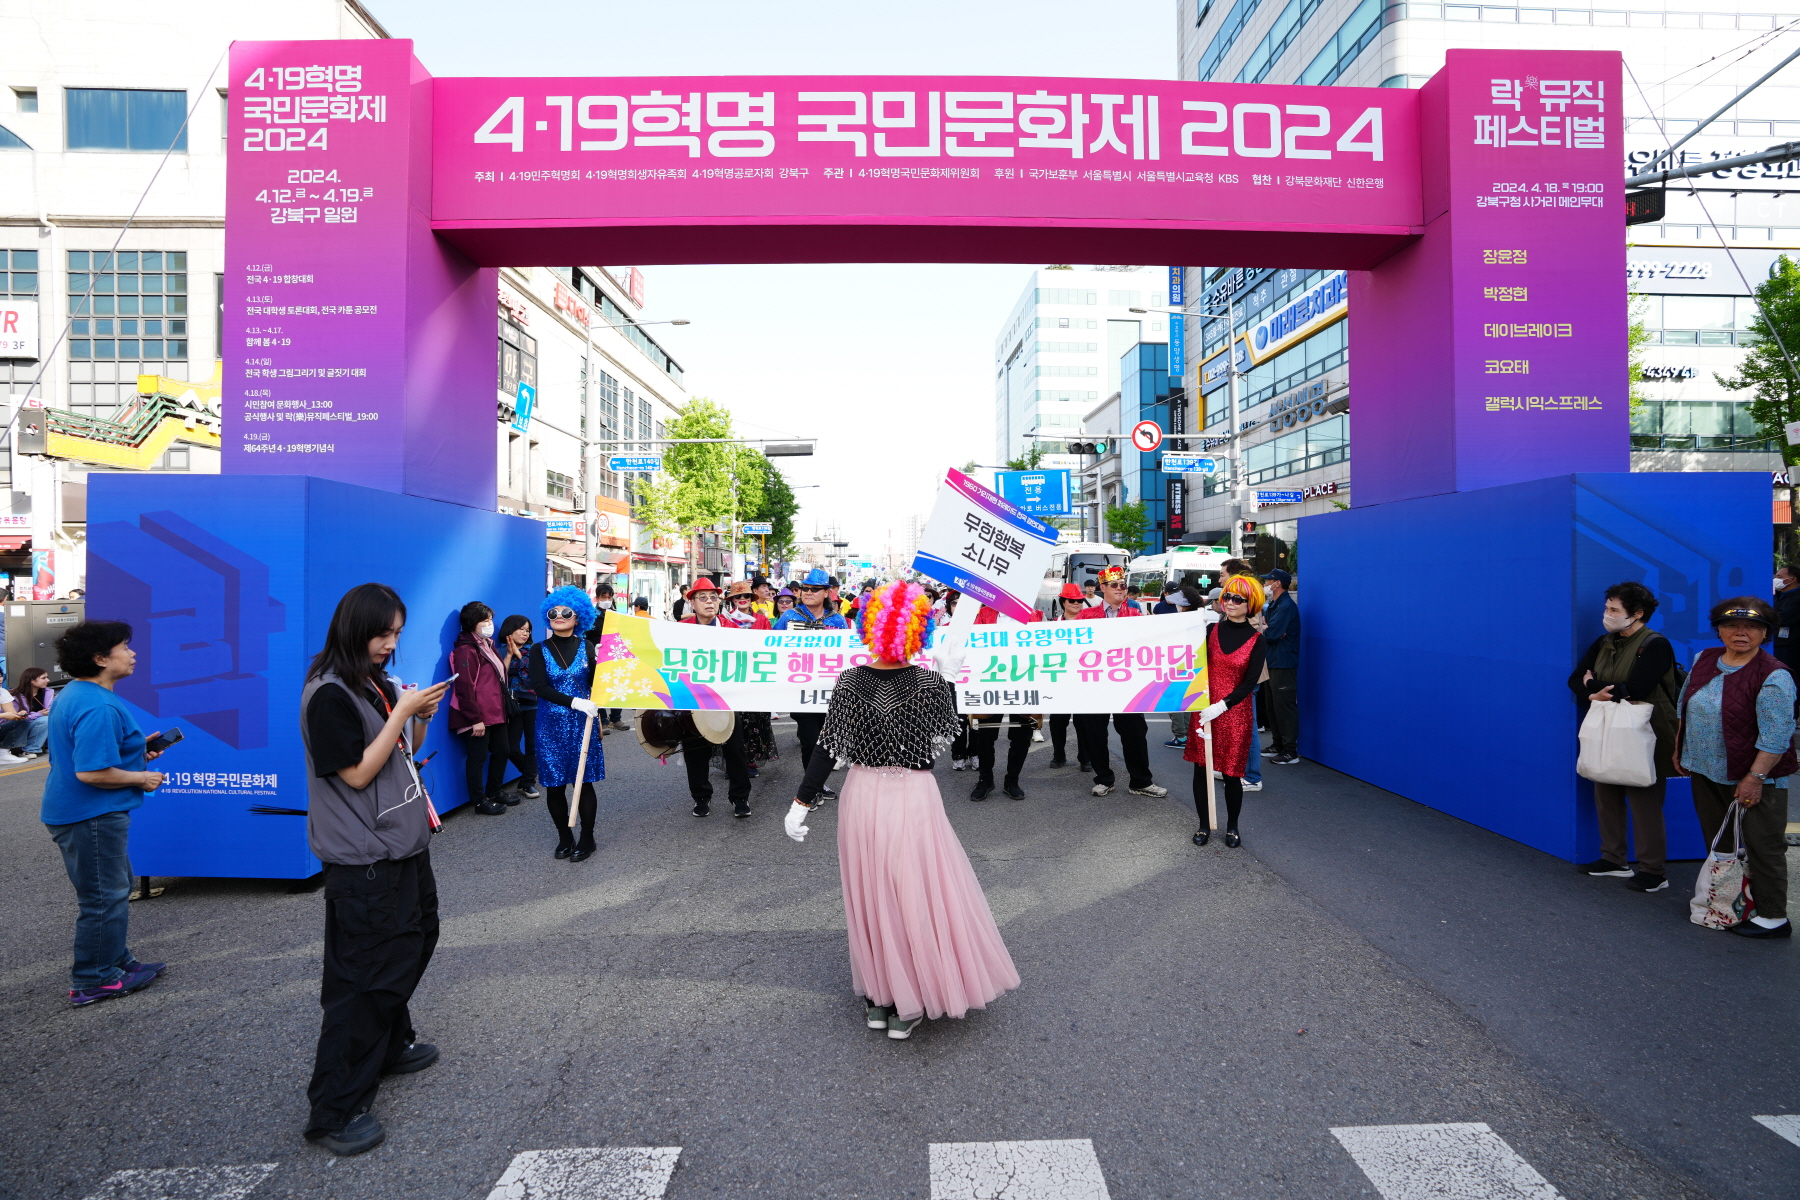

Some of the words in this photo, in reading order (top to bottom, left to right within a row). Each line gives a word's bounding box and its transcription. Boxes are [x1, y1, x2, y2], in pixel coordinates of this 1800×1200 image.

[244, 65, 362, 92] 4·19혁명
[243, 95, 386, 123] 국민문화제
[474, 90, 775, 158] 4·19혁명
[797, 90, 1160, 160] 국민문화제
[1181, 101, 1384, 161] 2024
[1474, 115, 1605, 148] 페스티벌
[243, 127, 328, 151] 2024
[287, 169, 341, 183] 2024.
[474, 171, 495, 182] 주최
[509, 170, 580, 181] 4·19민주혁명회
[586, 169, 687, 180] 4·19혁명희생자유족회
[692, 168, 774, 179] 4·19혁명공로자회
[779, 168, 809, 179] 강북구
[823, 168, 844, 179] 주관
[858, 168, 980, 179] 4·19혁명국민문화제위원회
[994, 168, 1014, 179] 후원
[1028, 168, 1078, 180] 국가보훈부
[1083, 169, 1132, 182] 서울특별시
[1137, 170, 1214, 184] 서울특별시교육청
[1218, 174, 1239, 183] KBS
[1252, 174, 1272, 186] 협찬
[1285, 175, 1342, 188] 강북문화재단
[1346, 177, 1384, 189] 신한은행
[1571, 183, 1604, 193] 19:00
[1476, 196, 1521, 208] 강북구청
[1523, 196, 1556, 208] 사거리
[1558, 196, 1604, 208] 메인무대
[270, 207, 321, 224] 강북구
[324, 206, 357, 223] 일원
[1483, 249, 1527, 264] 장윤정
[246, 275, 262, 284] 전국
[283, 274, 314, 284] 합창대회
[1483, 287, 1528, 301] 박정현
[246, 306, 262, 315] 전국
[263, 306, 286, 315] 대학생
[321, 305, 336, 315] 전국
[338, 305, 353, 315] 카툰
[354, 305, 377, 315] 공모전
[1483, 323, 1572, 338] 데이브레이크
[246, 337, 262, 347] 함께
[245, 368, 261, 378] 전국
[262, 368, 277, 378] 학생
[278, 368, 317, 378] 그림그리기
[327, 368, 349, 378] 글짓기
[351, 368, 367, 378] 대회
[1485, 360, 1529, 374] 코요태
[244, 400, 275, 410] 시민참여
[1485, 396, 1603, 411] 갤럭시익스프레스
[244, 413, 275, 422] 공식행사
[243, 444, 276, 453] 제64주년
[964, 512, 1026, 560] 무한행복
[961, 542, 1010, 576] 소나무
[764, 635, 842, 648] 어김없이
[1015, 627, 1094, 646] 유랑악단
[662, 648, 778, 684] 무한대로
[980, 653, 1068, 682] 소나무
[1077, 646, 1199, 682] 유랑악단
